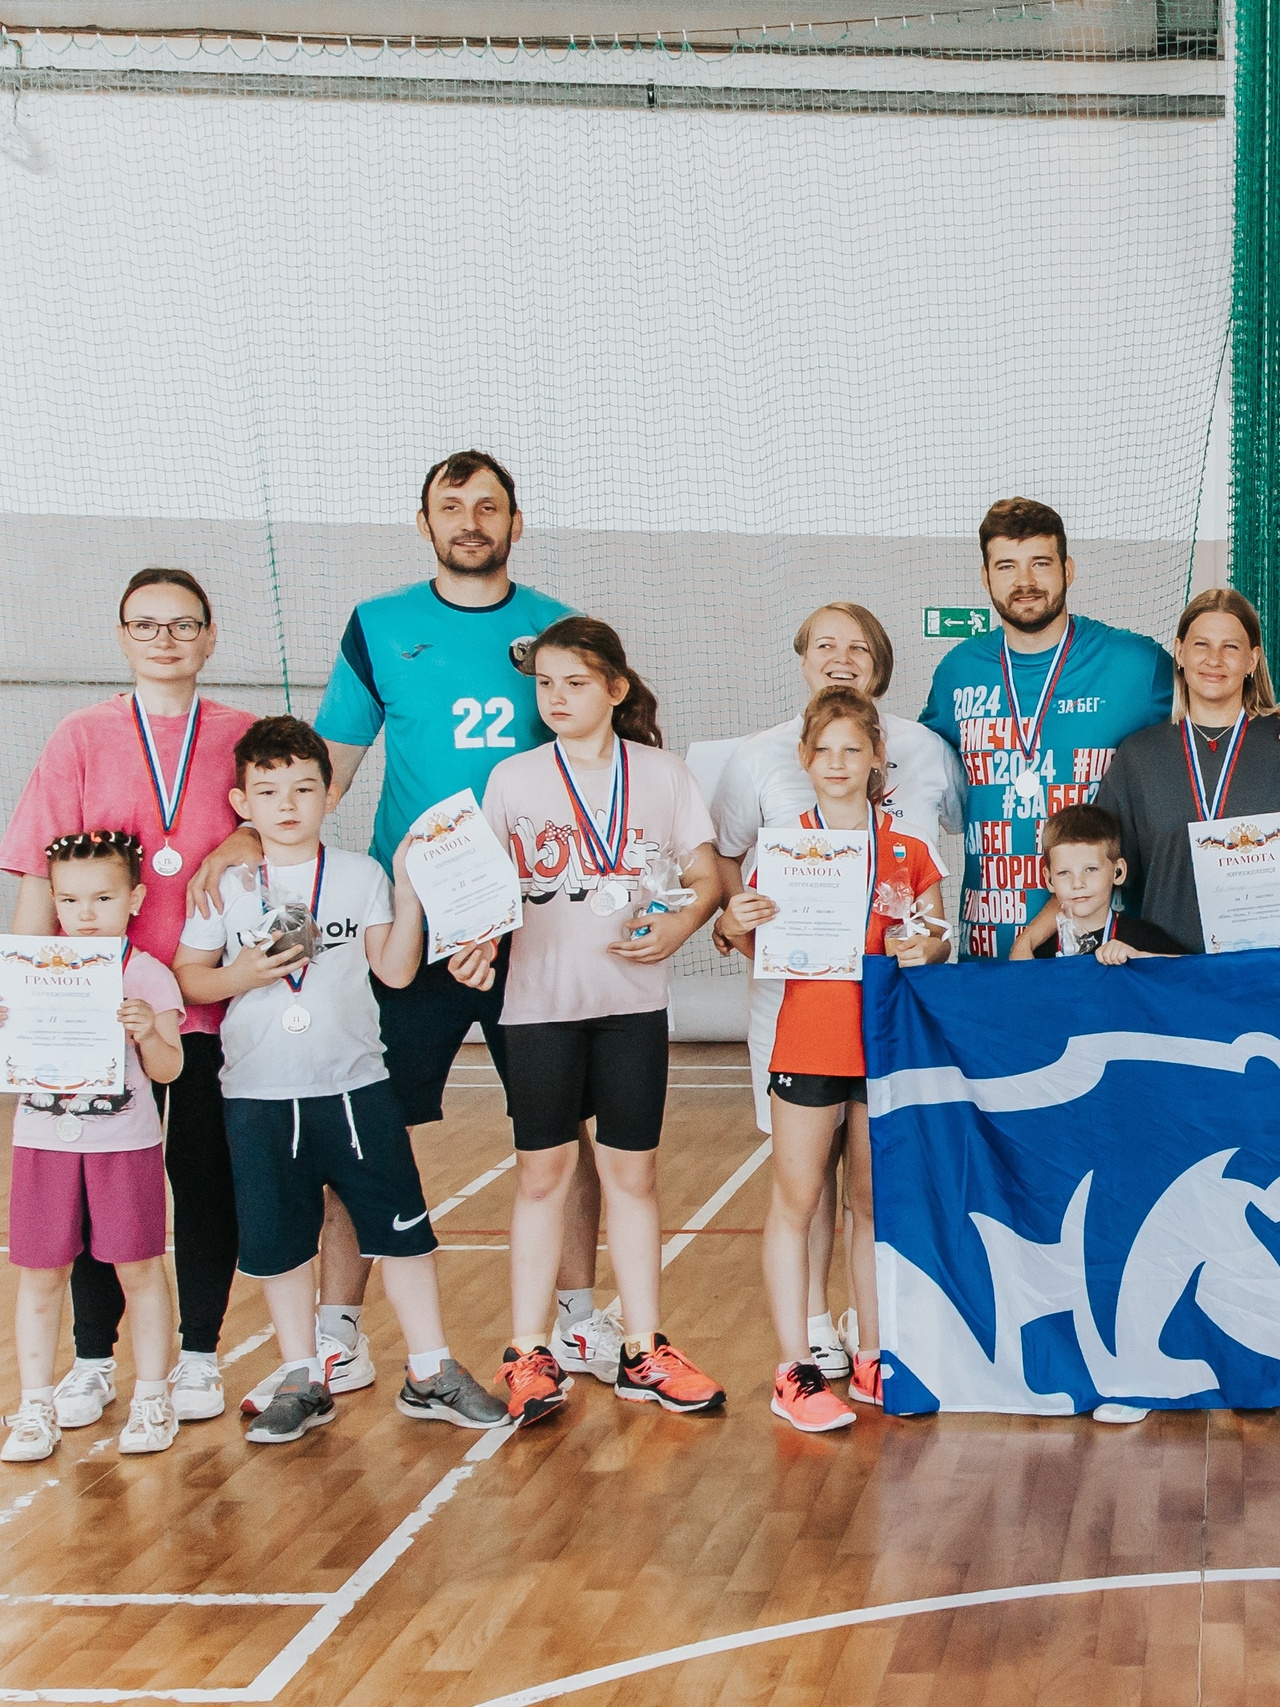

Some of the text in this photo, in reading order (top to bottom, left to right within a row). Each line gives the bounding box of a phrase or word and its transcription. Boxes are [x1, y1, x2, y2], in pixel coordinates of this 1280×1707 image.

[953, 685, 1001, 721] 2024
[452, 697, 516, 749] 22
[422, 835, 471, 862] ГРАМОТА
[1218, 853, 1276, 867] ГРАМОТА
[783, 866, 842, 877] ГРАМОТА
[25, 975, 92, 986] ГРАМОТА
